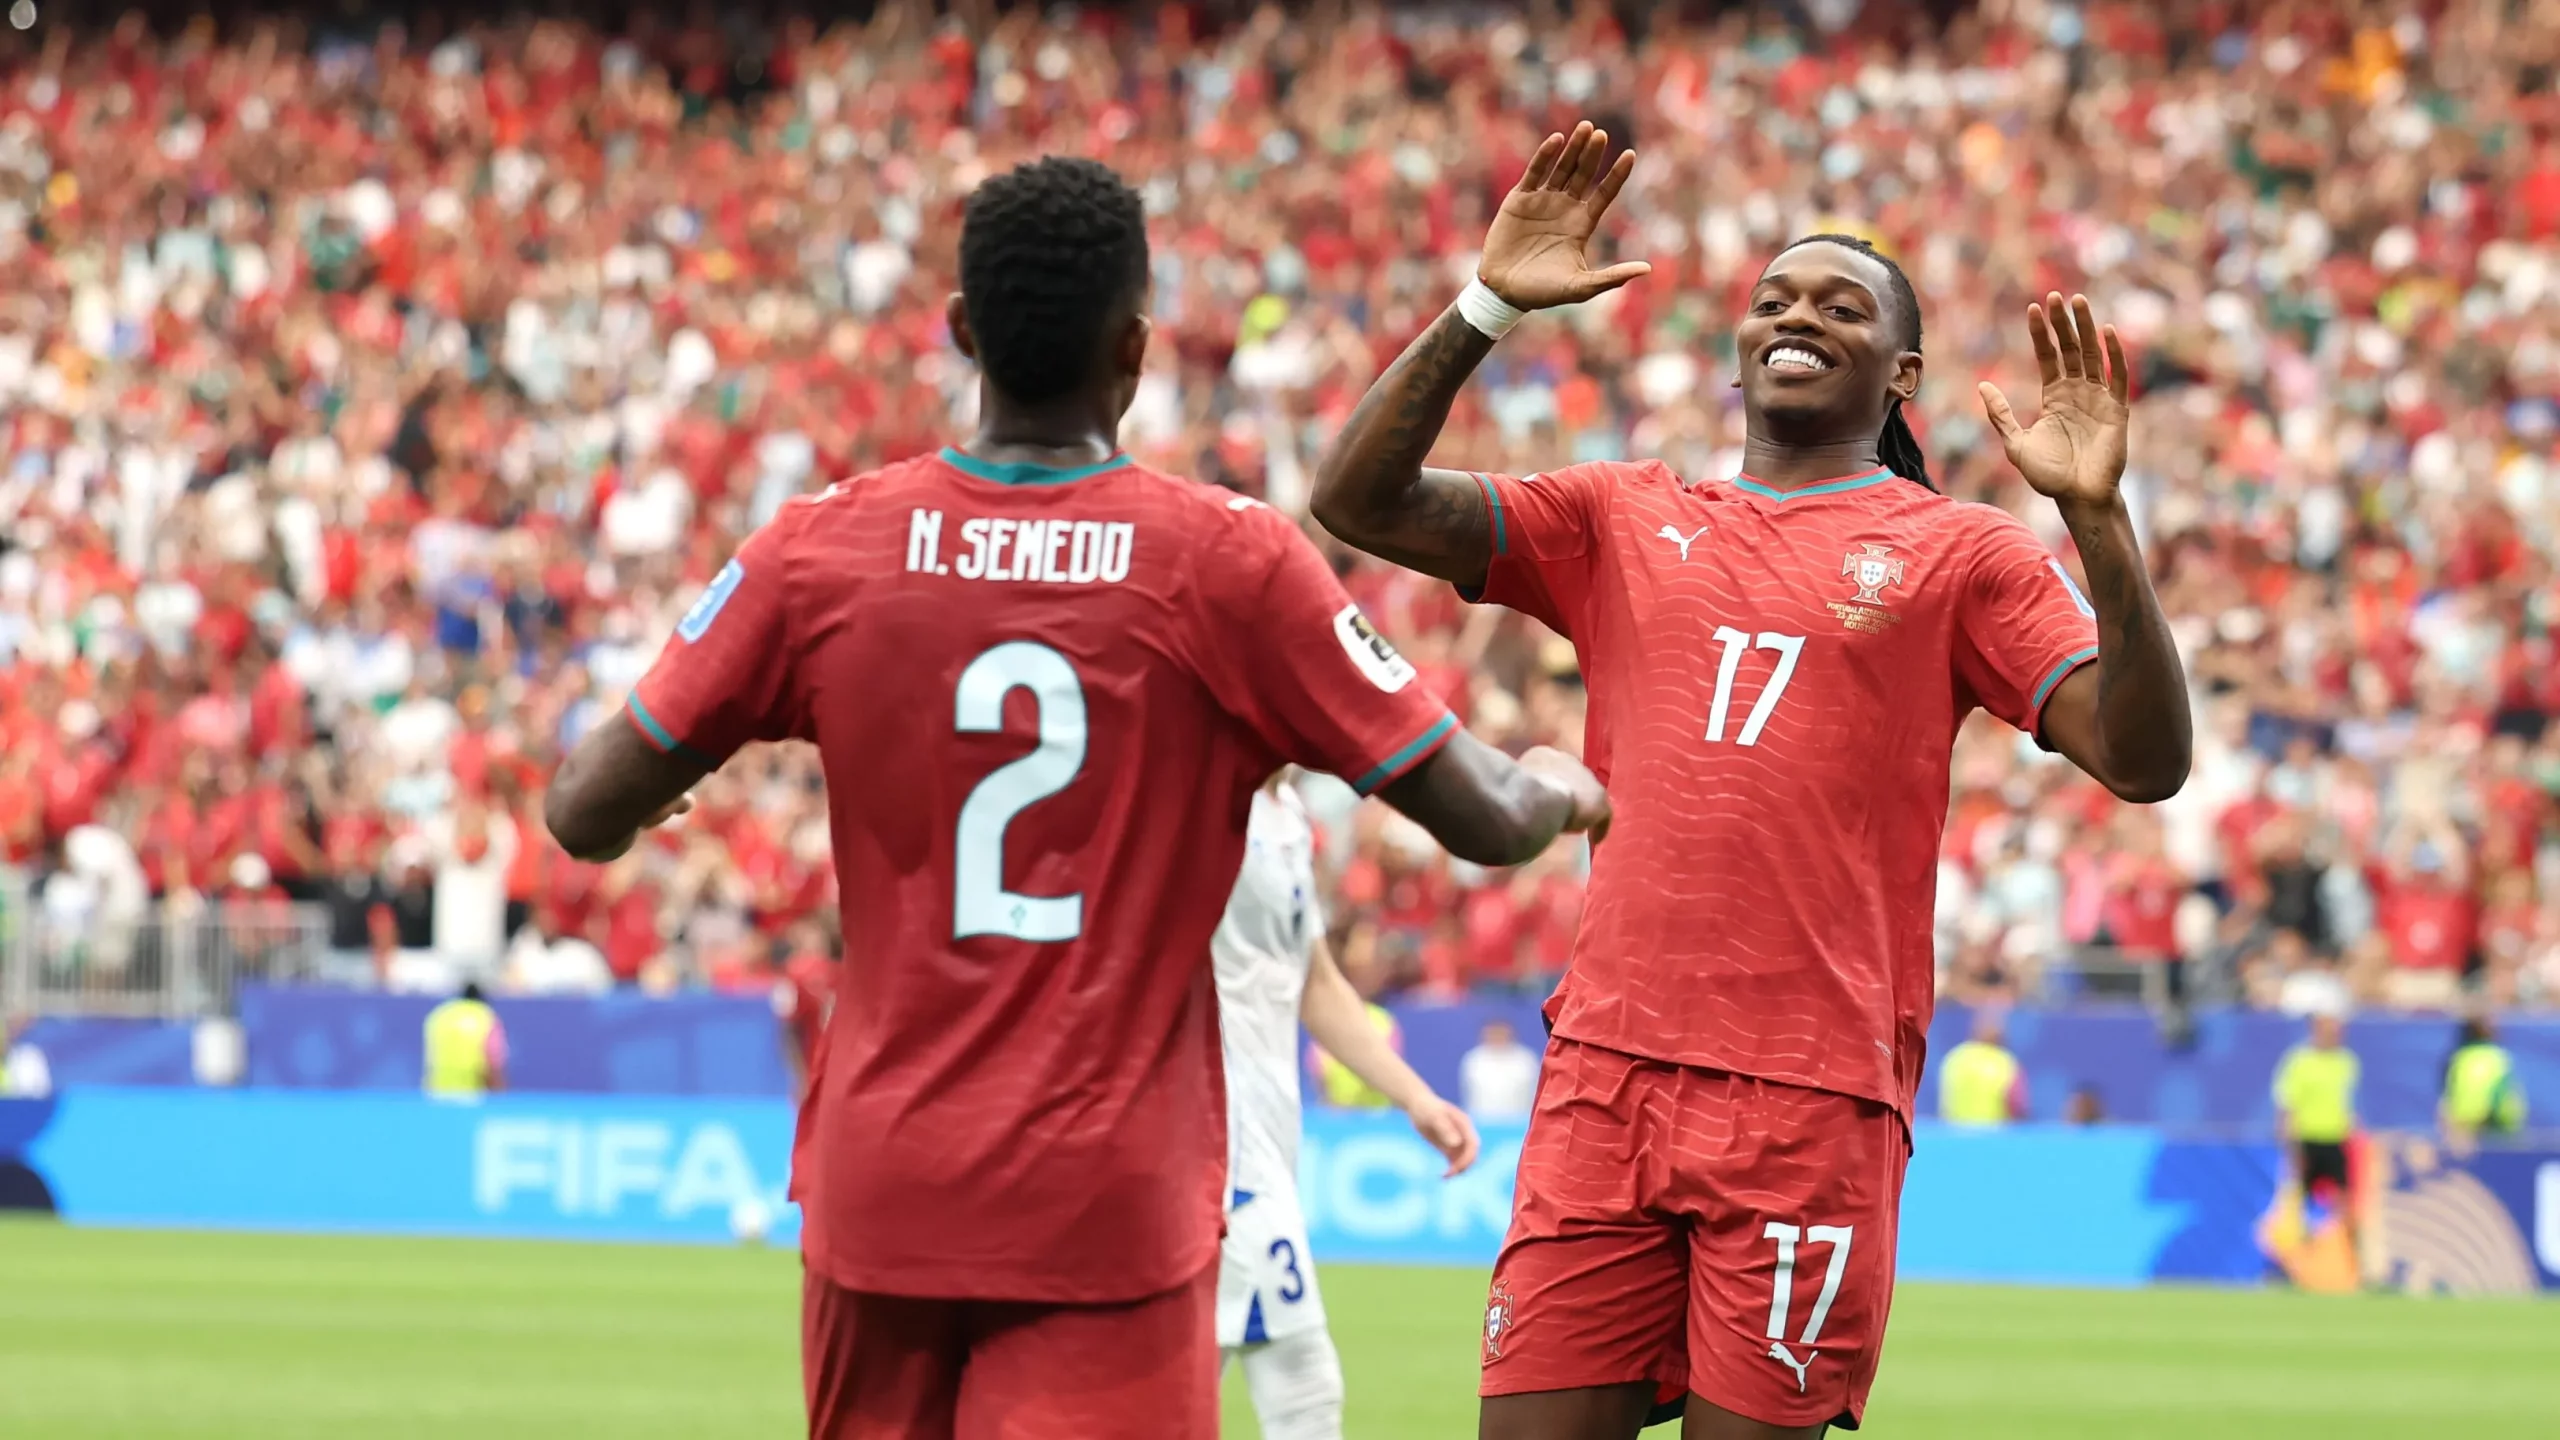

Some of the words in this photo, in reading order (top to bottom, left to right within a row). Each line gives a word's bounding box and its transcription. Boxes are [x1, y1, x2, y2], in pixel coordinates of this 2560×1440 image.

[906, 507, 949, 576] N.
[955, 518, 1135, 584] SEMEDO
[1826, 601, 1857, 614] PORTUGAL
[1843, 620, 1880, 635] HOUSTON
[1847, 613, 1870, 624] JUNHO
[1704, 625, 1807, 747] 17
[953, 640, 1088, 943] 2
[1268, 1238, 1305, 1304] 3
[1763, 1221, 1854, 1344] 17
